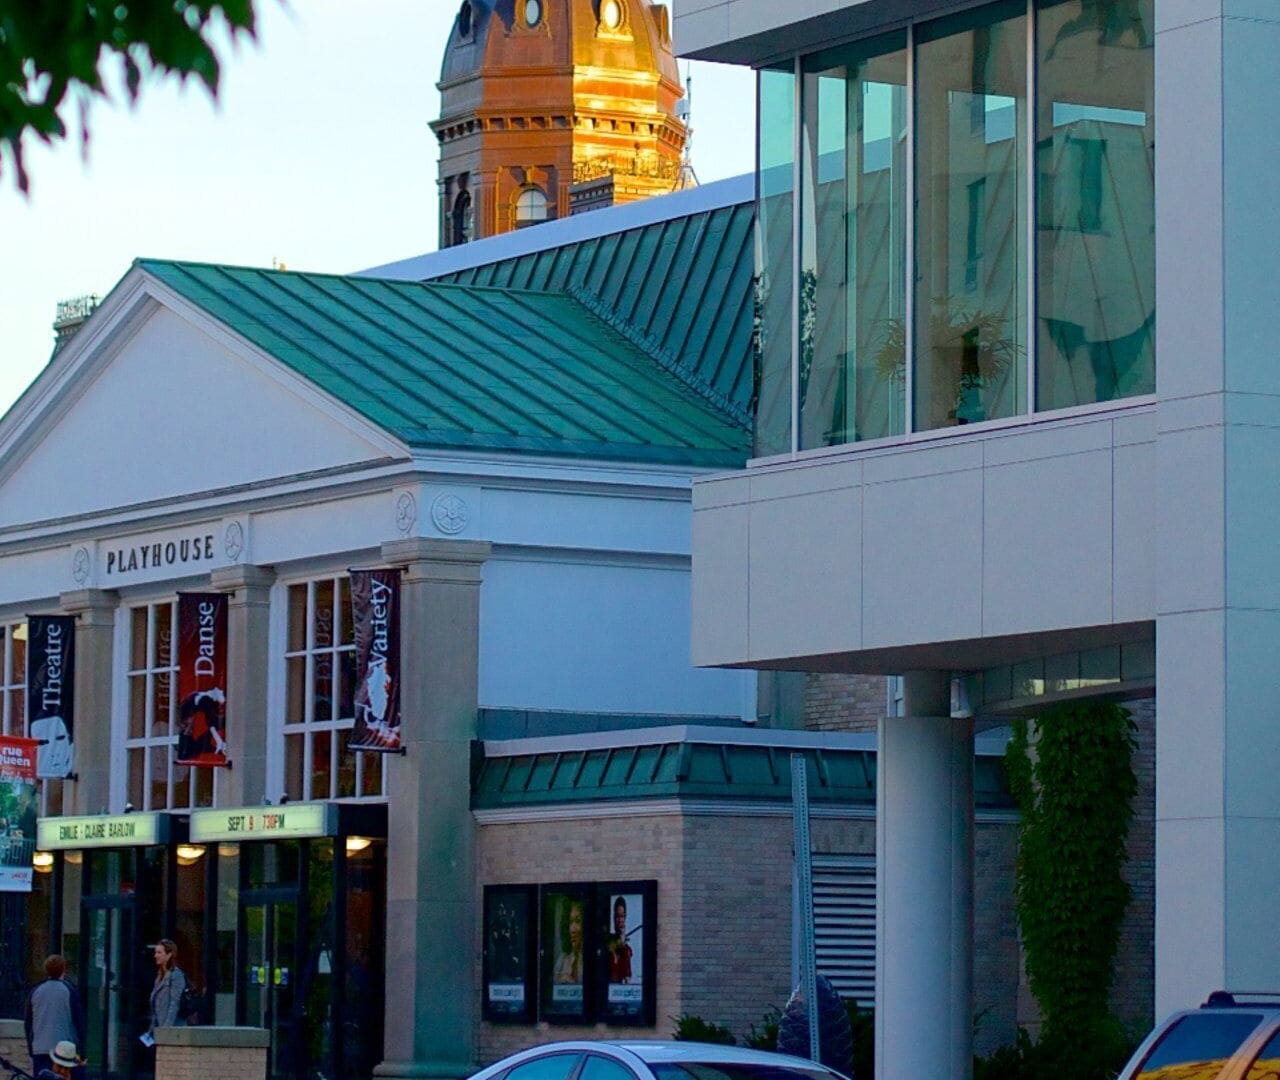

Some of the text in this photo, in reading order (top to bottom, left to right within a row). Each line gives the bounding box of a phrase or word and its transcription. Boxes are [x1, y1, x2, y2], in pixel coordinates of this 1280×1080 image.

[106, 535, 214, 575] PLAYHOUSE
[194, 601, 215, 678] Danse
[368, 577, 392, 669] Variety
[41, 623, 62, 711] Theatre
[2, 746, 23, 757] rue
[228, 816, 245, 831] SEPT
